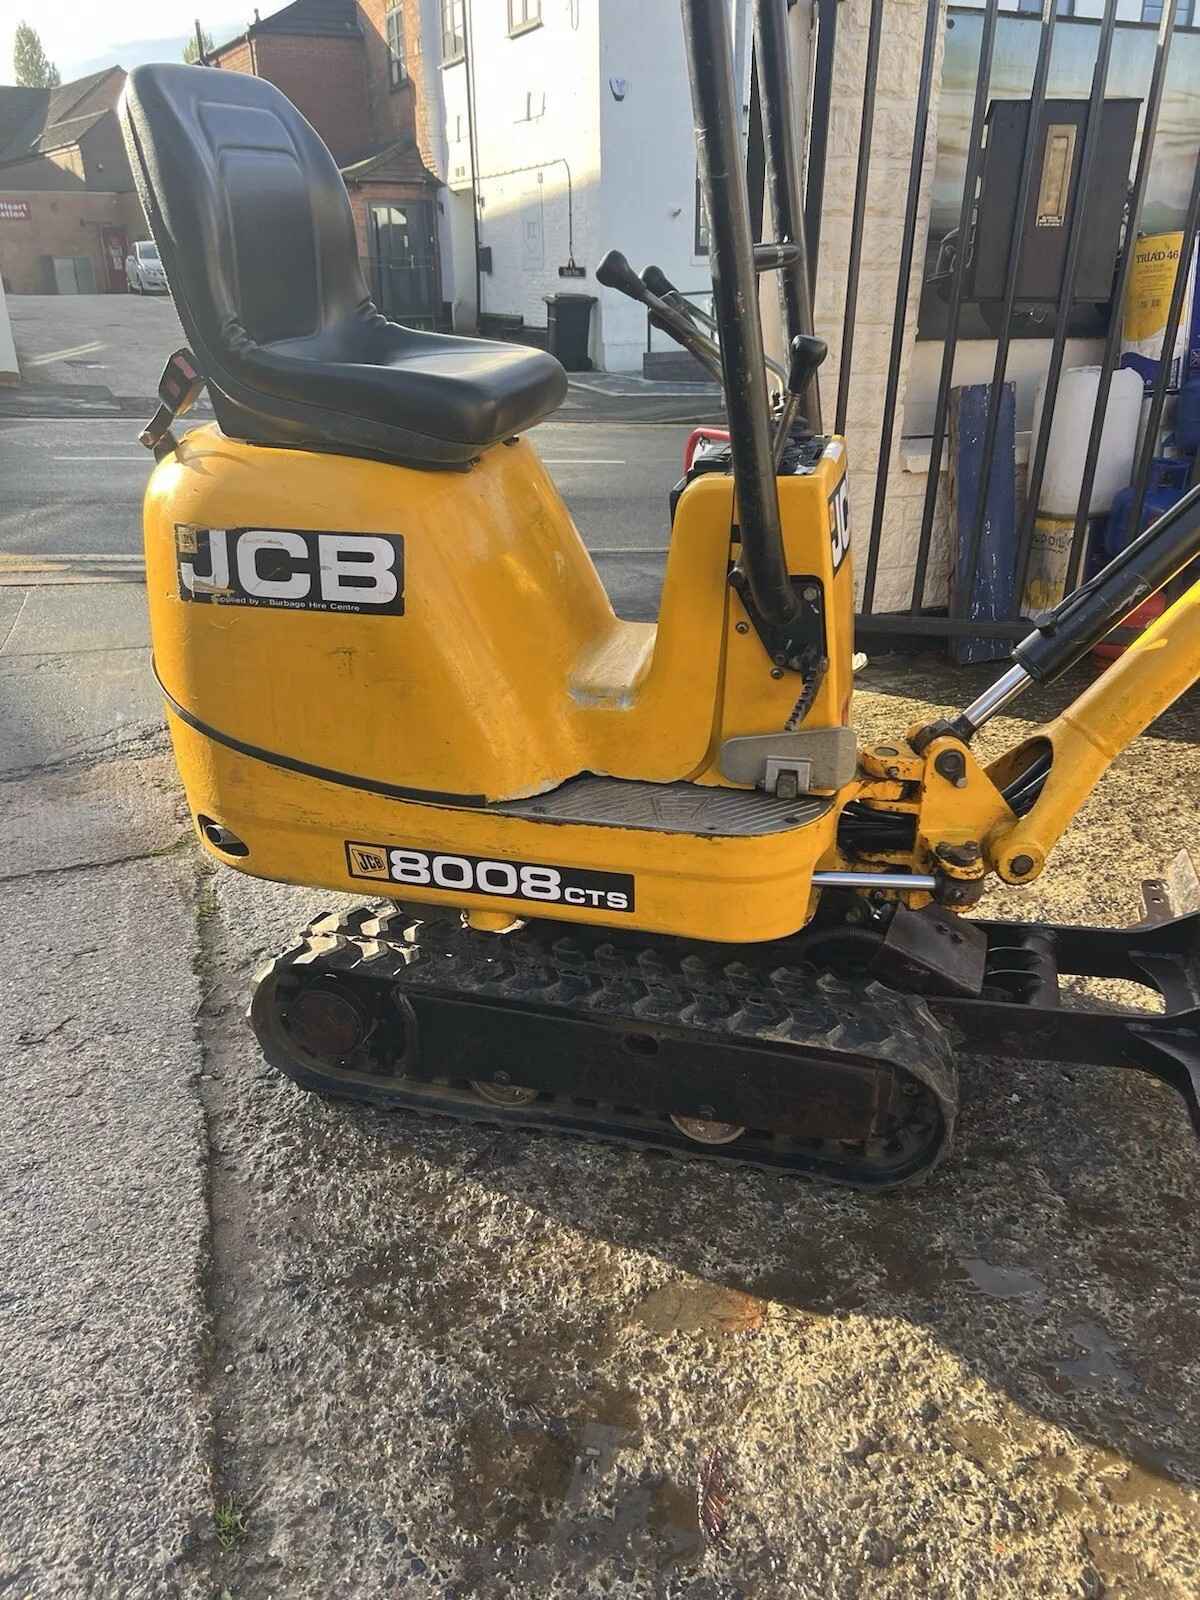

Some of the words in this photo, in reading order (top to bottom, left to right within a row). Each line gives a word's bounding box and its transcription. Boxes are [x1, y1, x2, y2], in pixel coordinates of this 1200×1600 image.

[1136, 250, 1166, 264] TRIAD
[1167, 249, 1179, 260] 46
[181, 529, 398, 604] JCB
[309, 601, 327, 609] Hire
[330, 602, 361, 612] Centre
[358, 852, 385, 872] JCB
[389, 850, 561, 901] 8008
[564, 887, 628, 910] CTS
